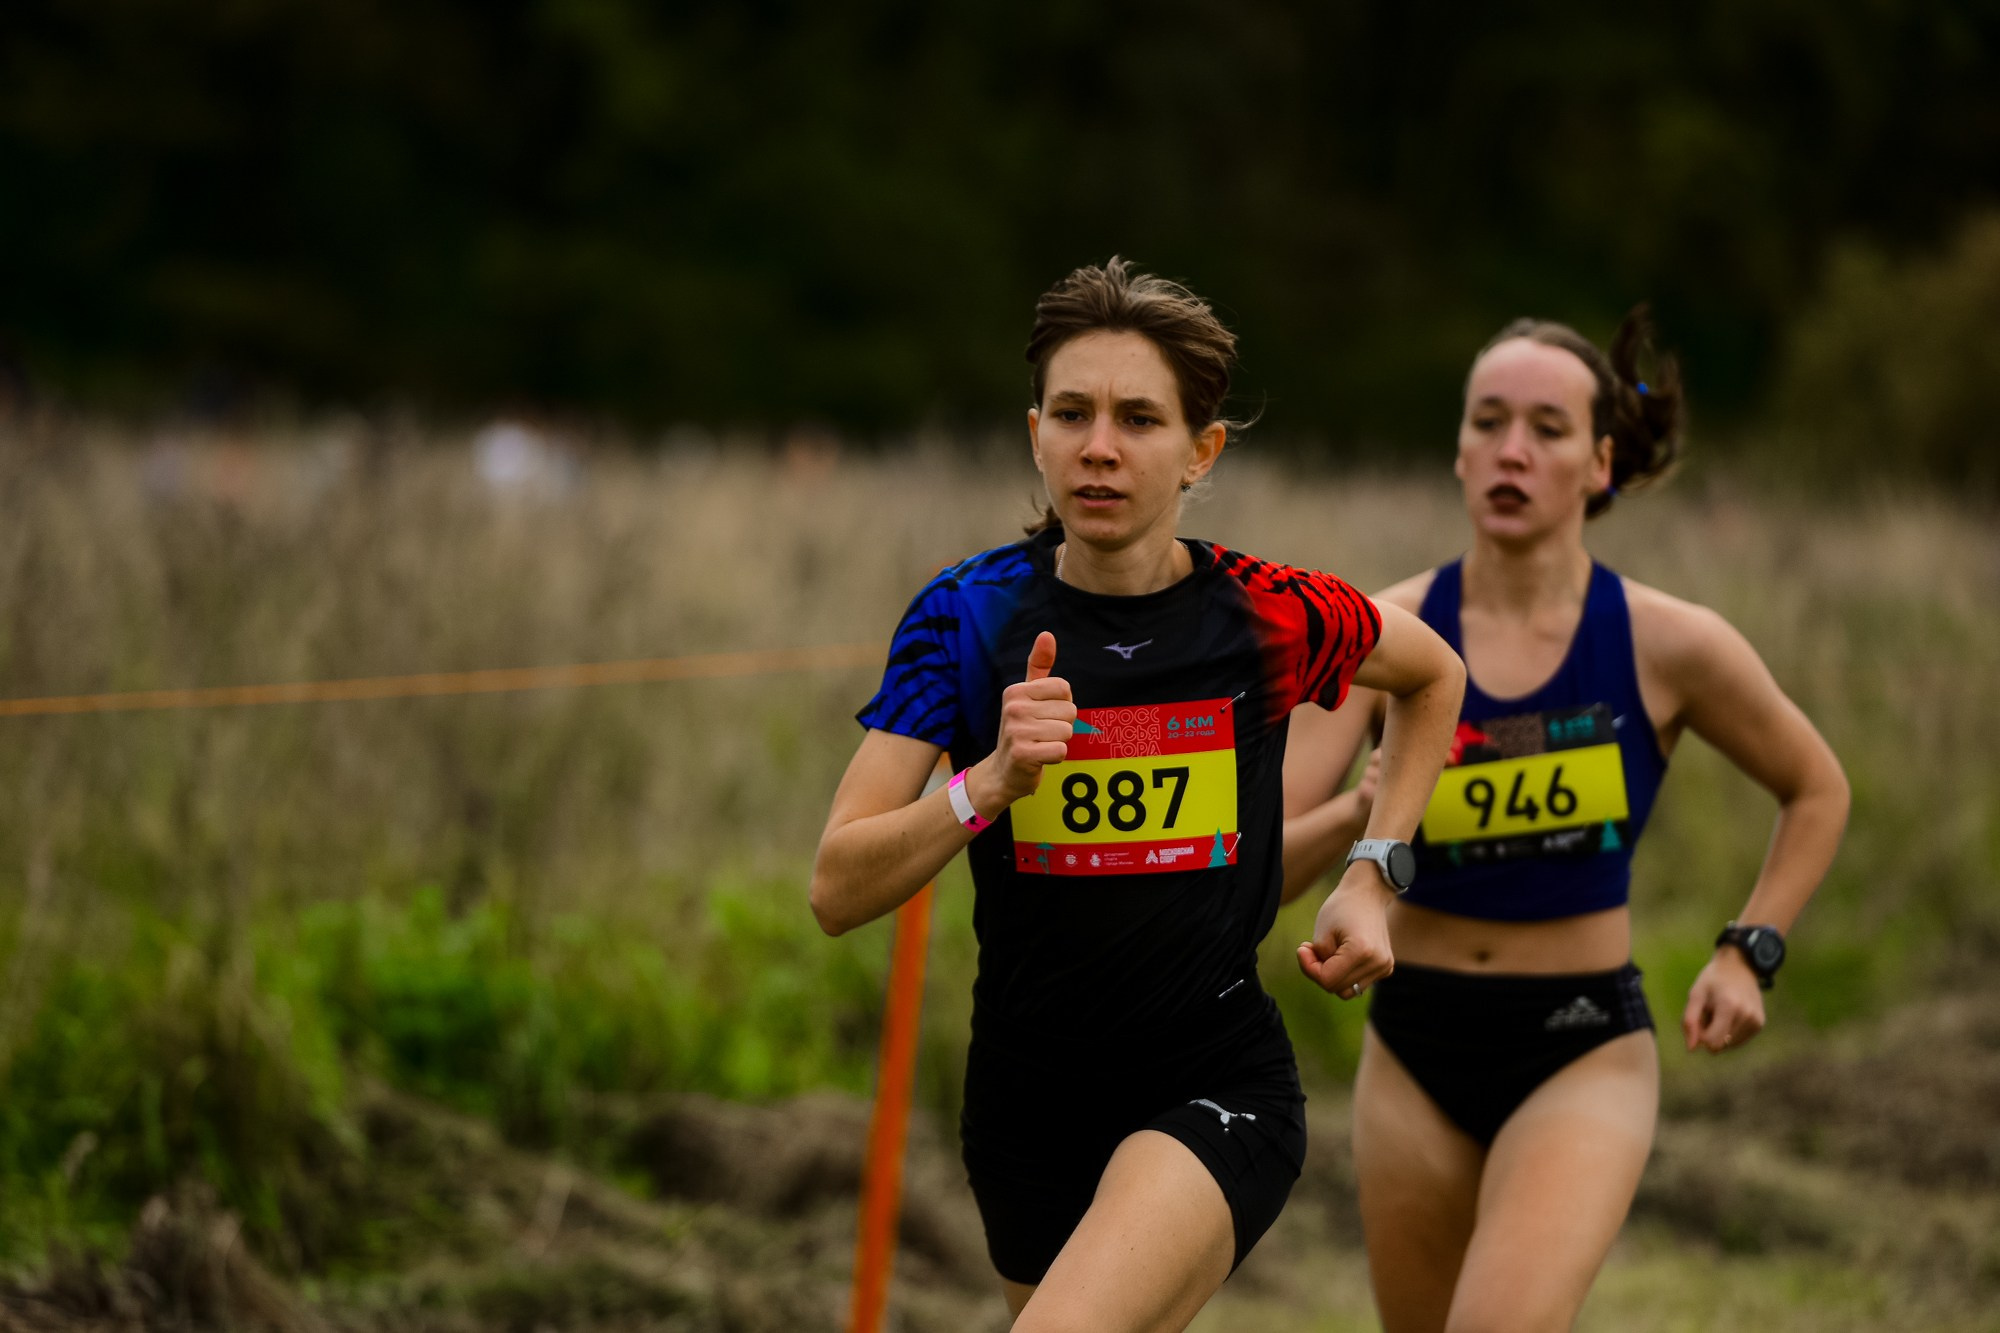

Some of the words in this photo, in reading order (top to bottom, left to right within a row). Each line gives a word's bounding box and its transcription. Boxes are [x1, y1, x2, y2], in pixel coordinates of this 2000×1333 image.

[1091, 707, 1160, 727] КРОСС
[1167, 716, 1180, 730] 6
[1185, 715, 1214, 728] КМ
[1089, 724, 1161, 744] ЛИСЬЯ
[1110, 740, 1161, 759] ГОРА
[1061, 766, 1190, 833] 887
[1464, 765, 1577, 829] 946
